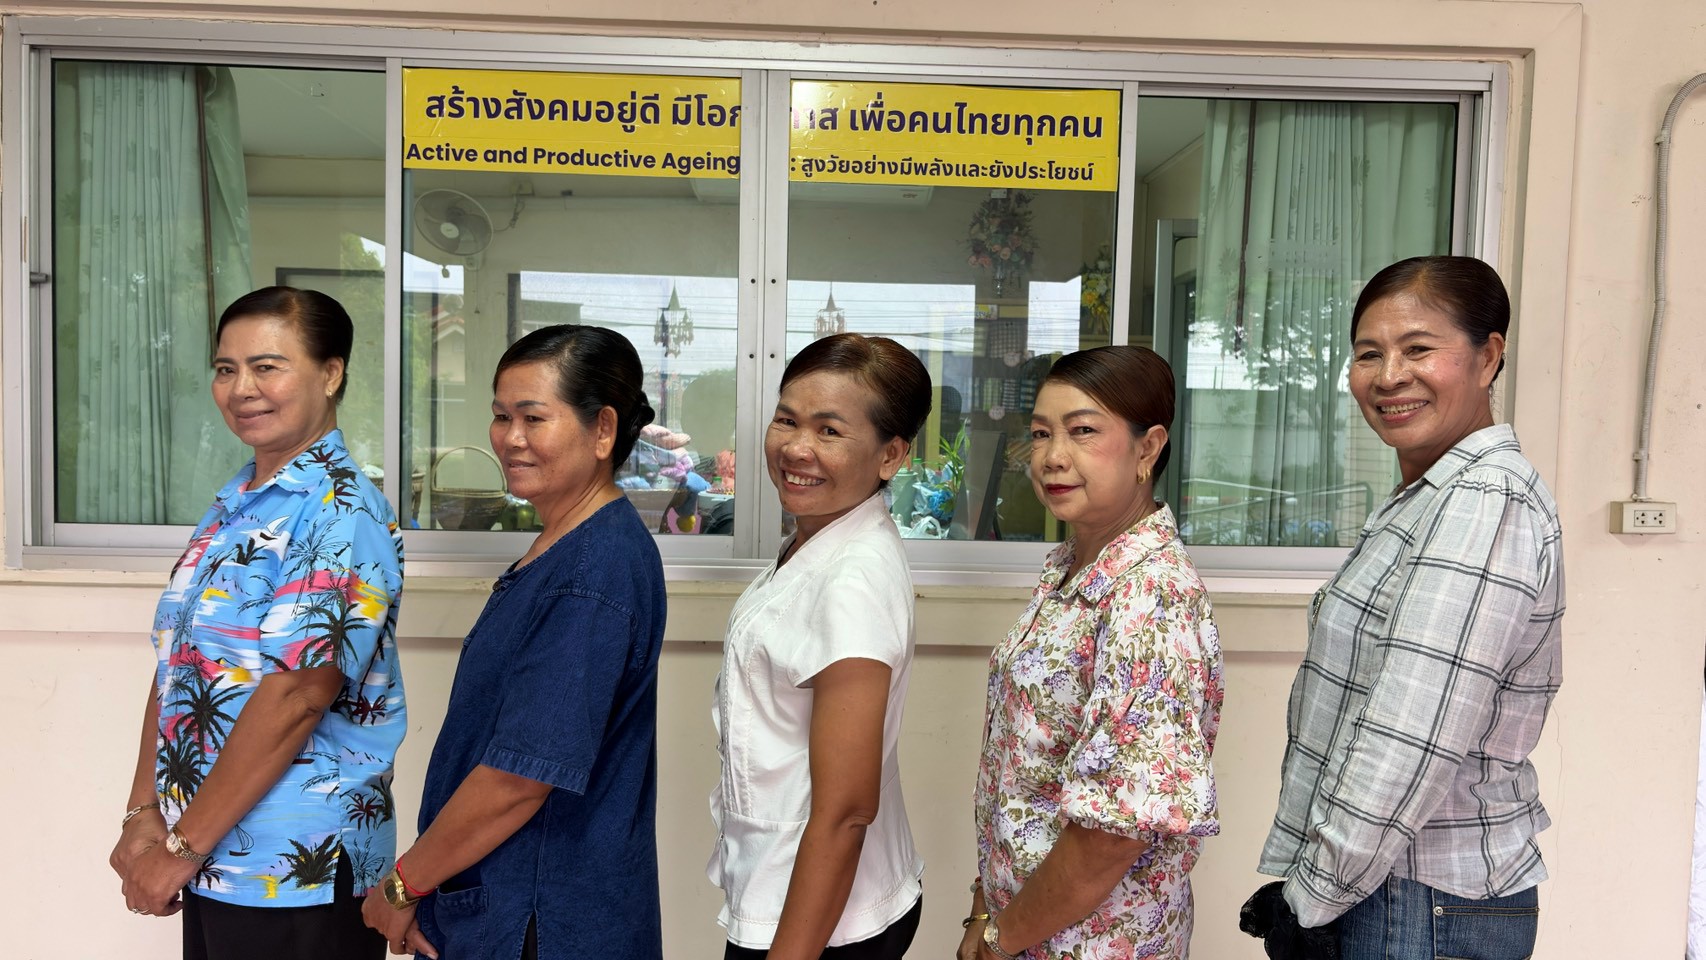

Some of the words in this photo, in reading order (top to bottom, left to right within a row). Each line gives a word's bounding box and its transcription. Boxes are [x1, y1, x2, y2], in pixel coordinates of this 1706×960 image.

[425, 85, 661, 134] สร้างสังคมอยู่ดี
[849, 91, 1103, 146] เพื่อคนไทยทุกคน
[405, 142, 478, 163] Active
[483, 146, 528, 164] and
[533, 147, 657, 169] Productive
[661, 151, 741, 176] Ageing
[801, 154, 1095, 182] สูงวัยอย่างมีพลังและยังประโยชน์
